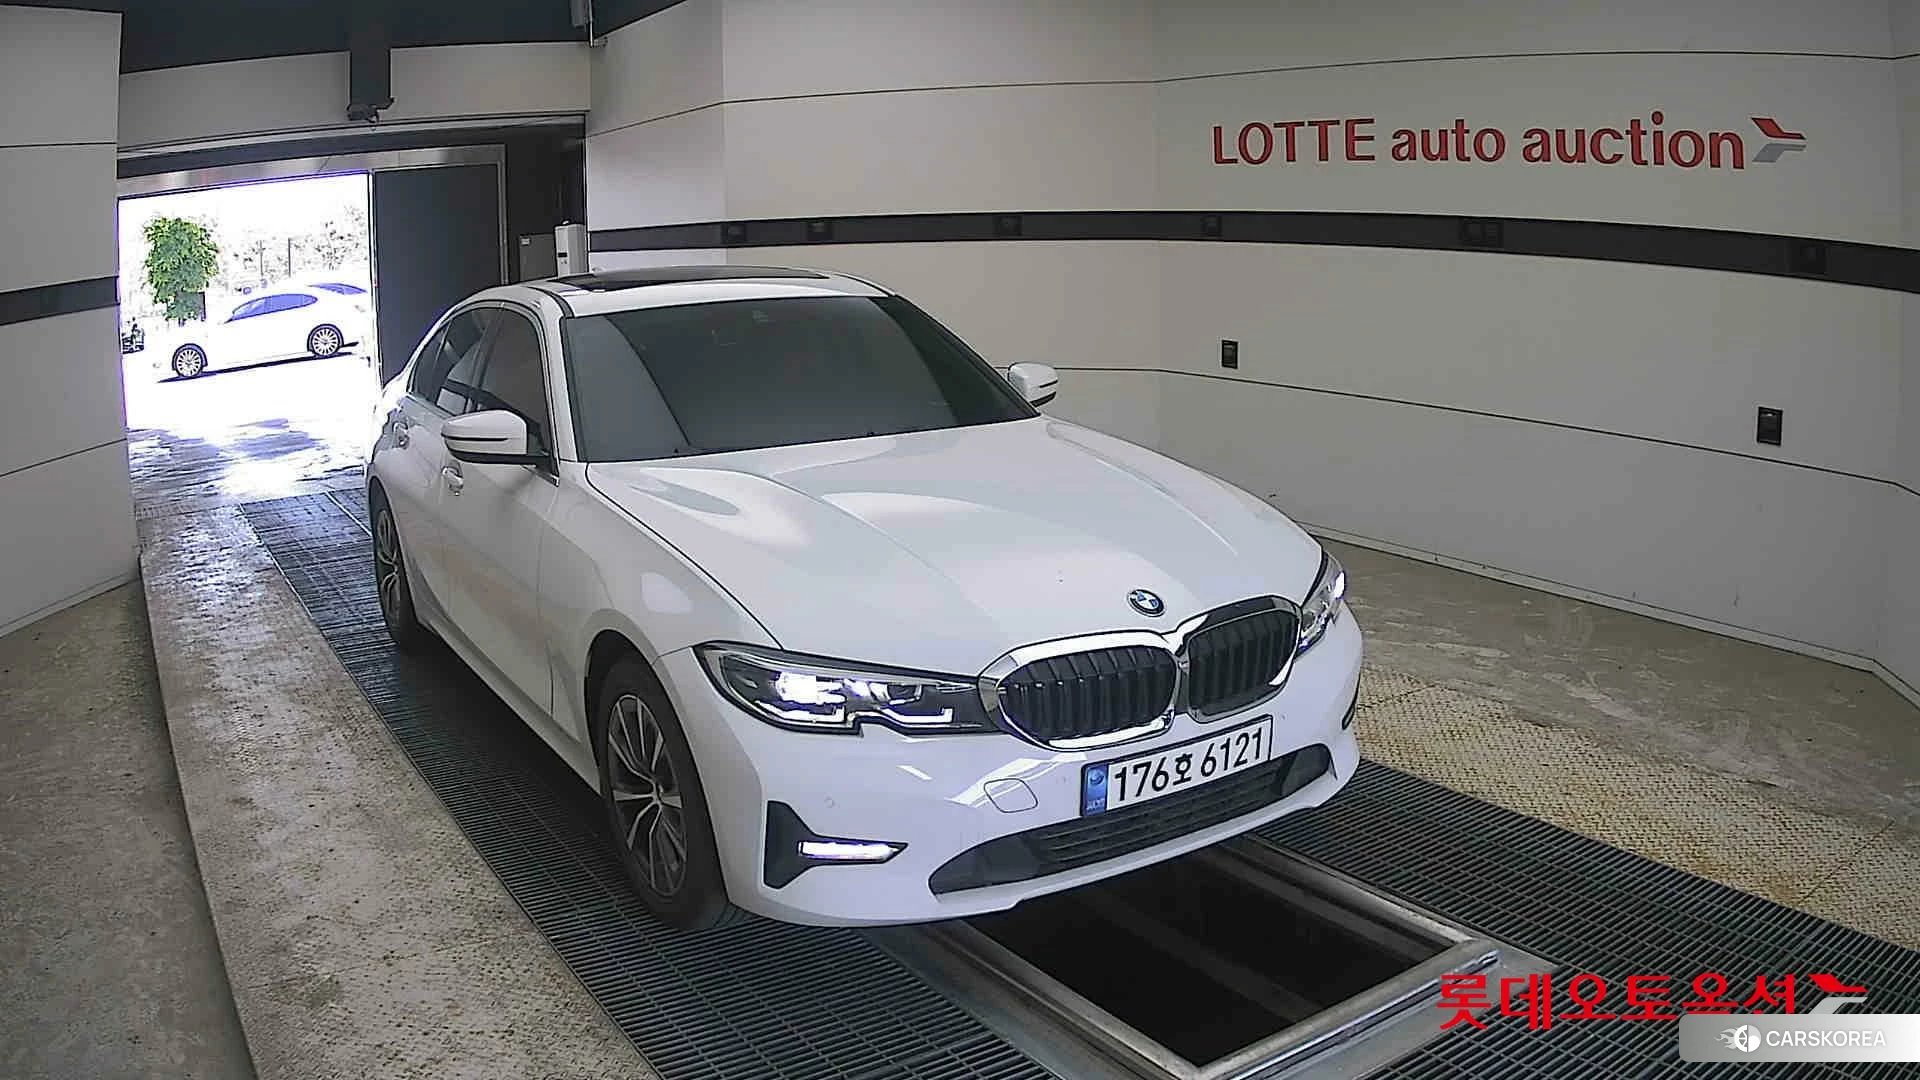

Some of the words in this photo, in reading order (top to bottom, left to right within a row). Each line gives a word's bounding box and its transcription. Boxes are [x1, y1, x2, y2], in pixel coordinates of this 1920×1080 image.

[1212, 118, 1377, 165] LOTTE
[1391, 118, 1506, 163] auto
[1522, 111, 1745, 170] auction
[1113, 752, 1193, 802] 176호
[1200, 727, 1263, 777] 6121
